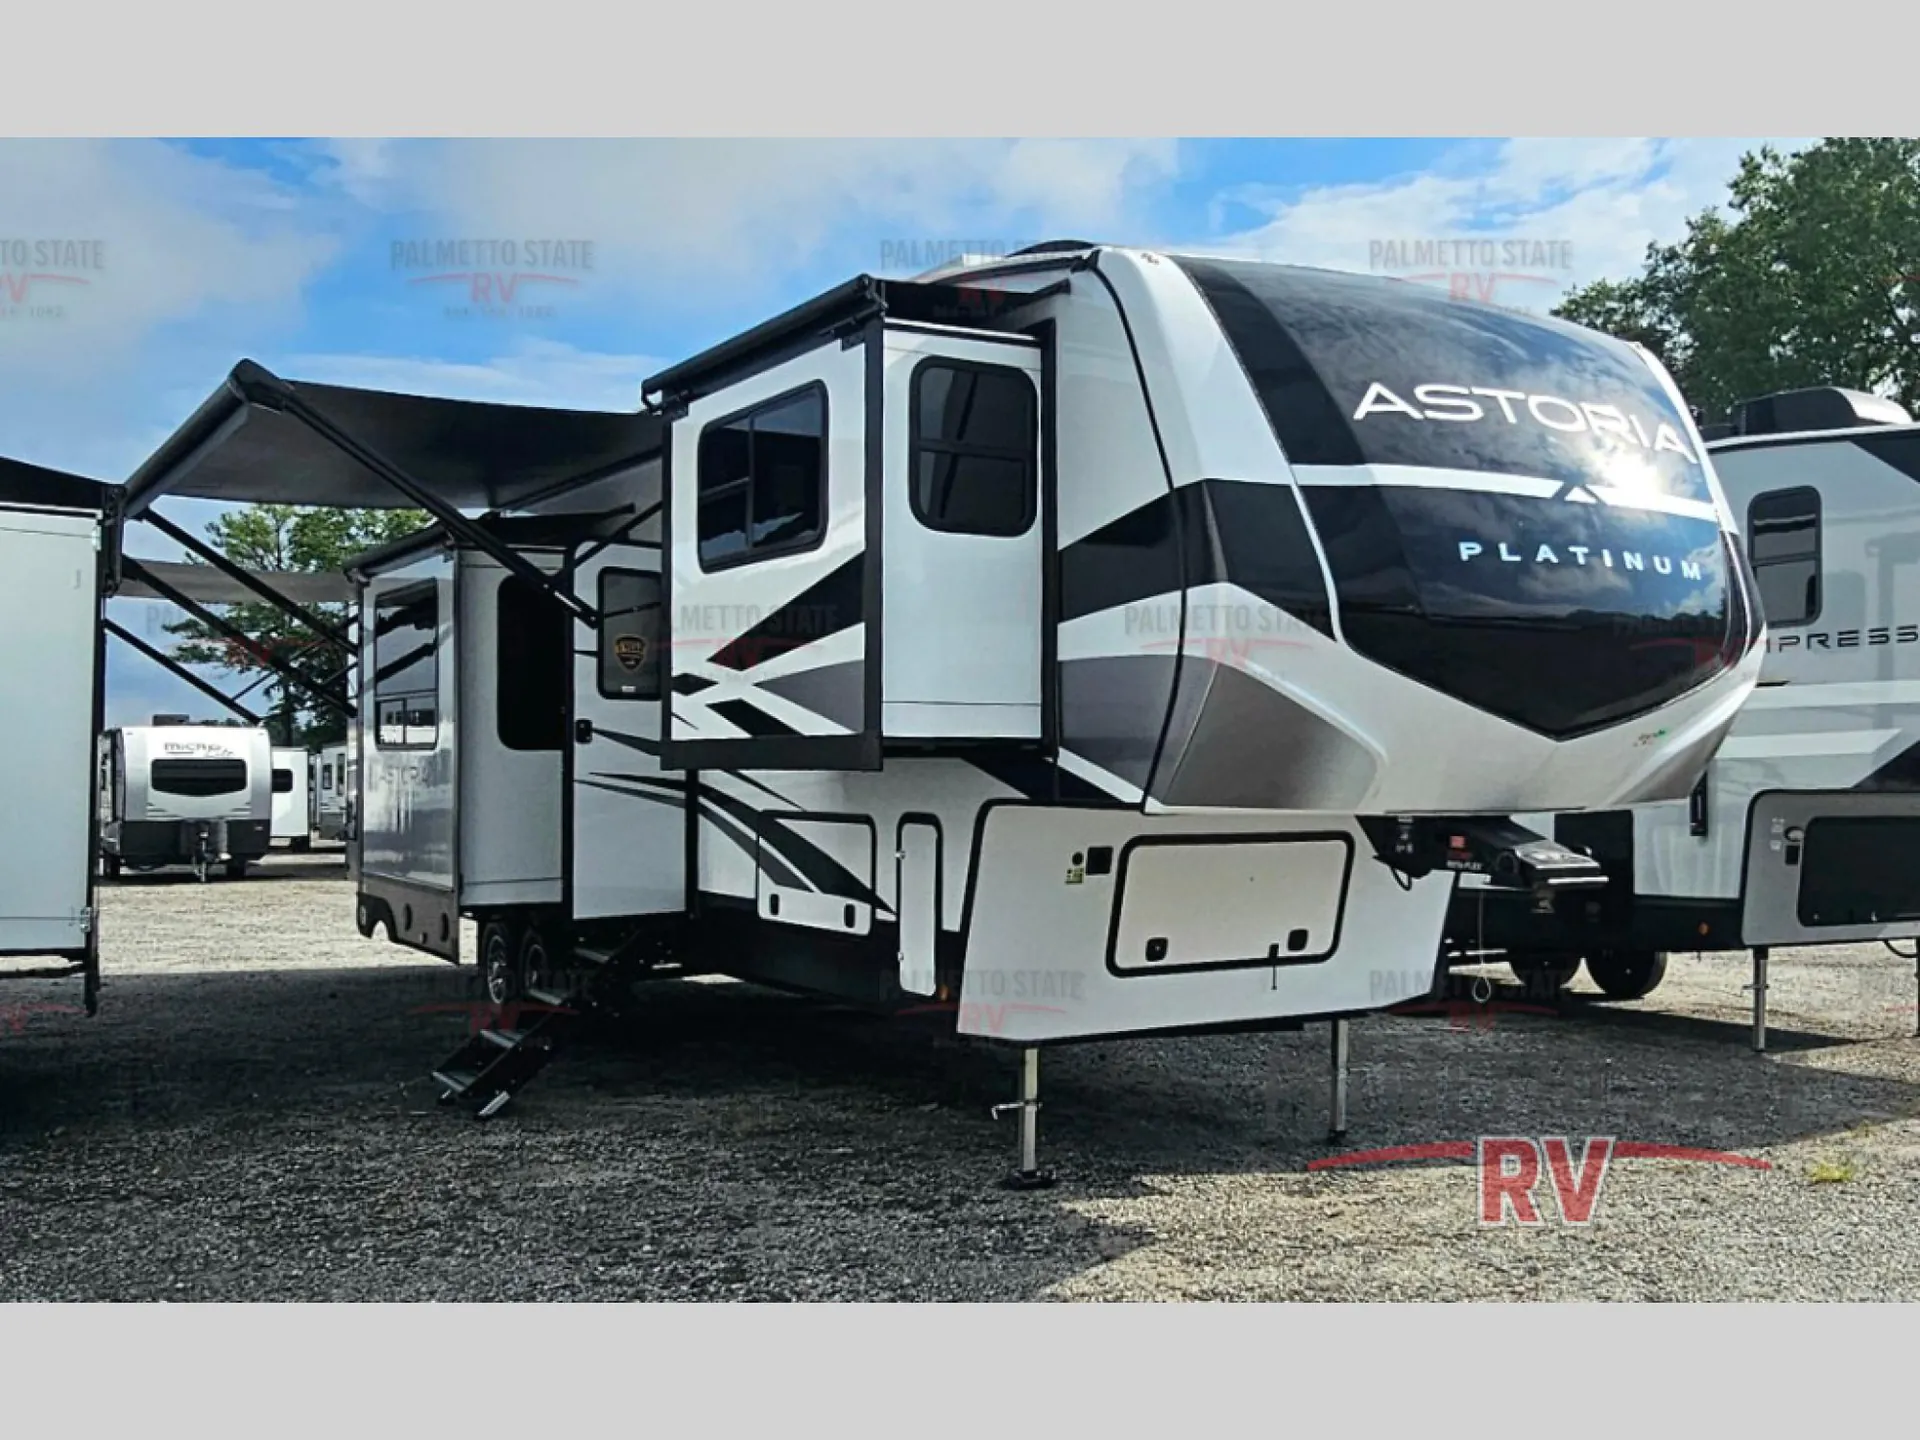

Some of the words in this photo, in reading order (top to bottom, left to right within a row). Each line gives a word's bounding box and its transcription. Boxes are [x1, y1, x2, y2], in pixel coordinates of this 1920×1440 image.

[1353, 382, 1698, 464] ASTORIA
[1458, 541, 1702, 581] PLATINUM
[1767, 624, 1919, 653] PRESS
